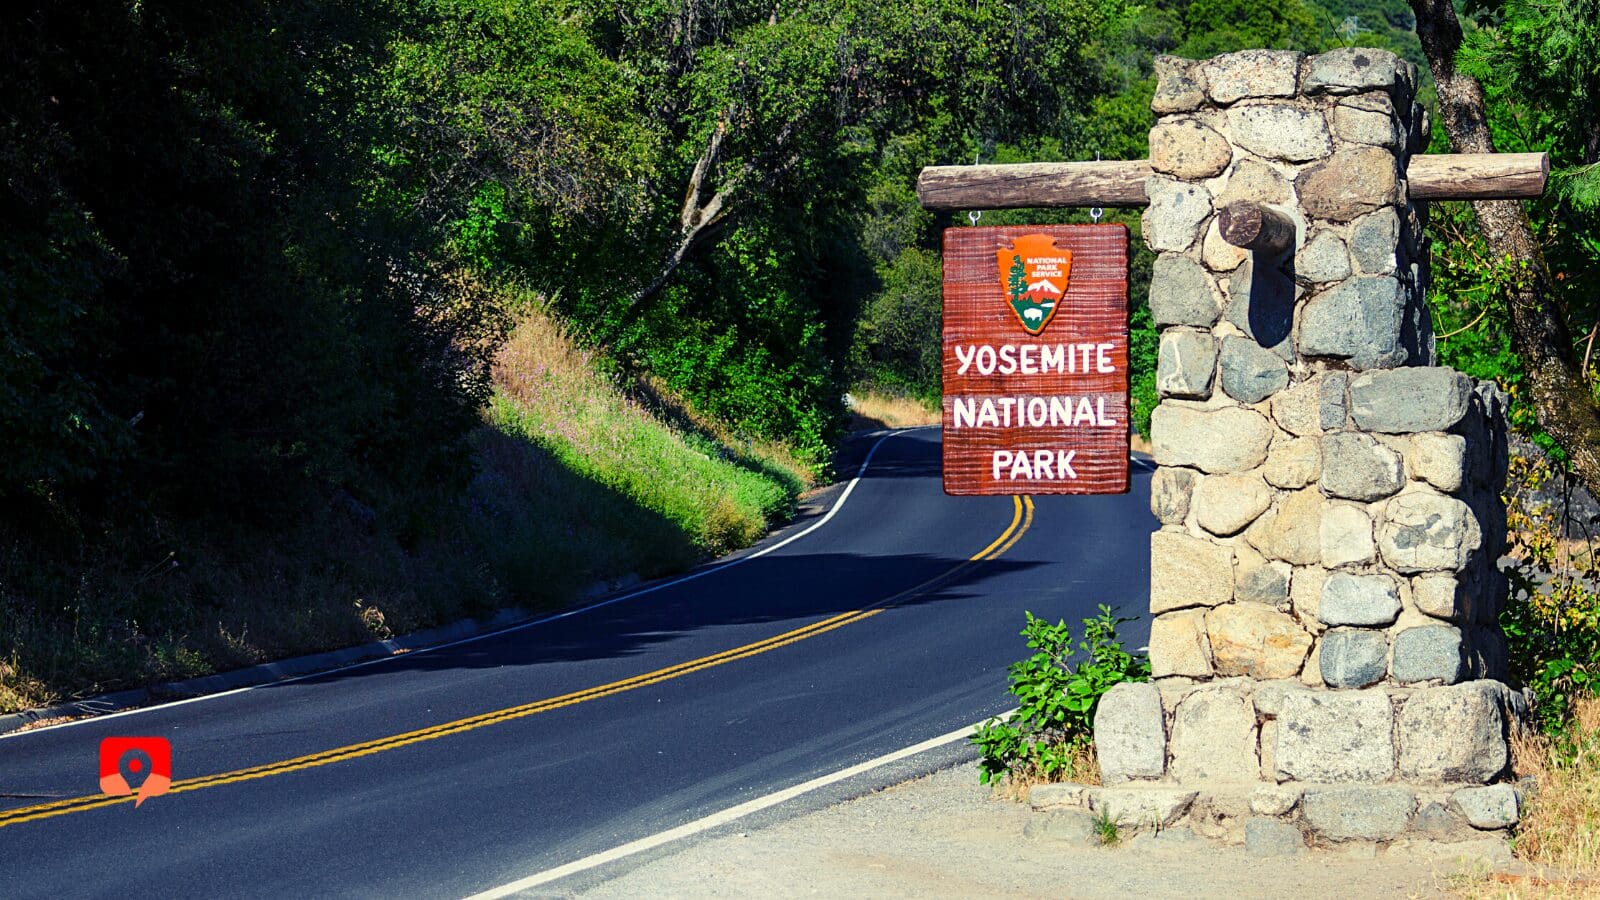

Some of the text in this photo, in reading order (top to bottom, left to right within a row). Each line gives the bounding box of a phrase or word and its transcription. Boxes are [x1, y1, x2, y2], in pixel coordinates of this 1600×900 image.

[1026, 257, 1067, 265] NATIONAL
[1031, 270, 1063, 278] SERVICE
[955, 343, 1116, 376] YOSEMITE
[953, 396, 1117, 428] NATIONAL
[992, 450, 1077, 480] PARK
